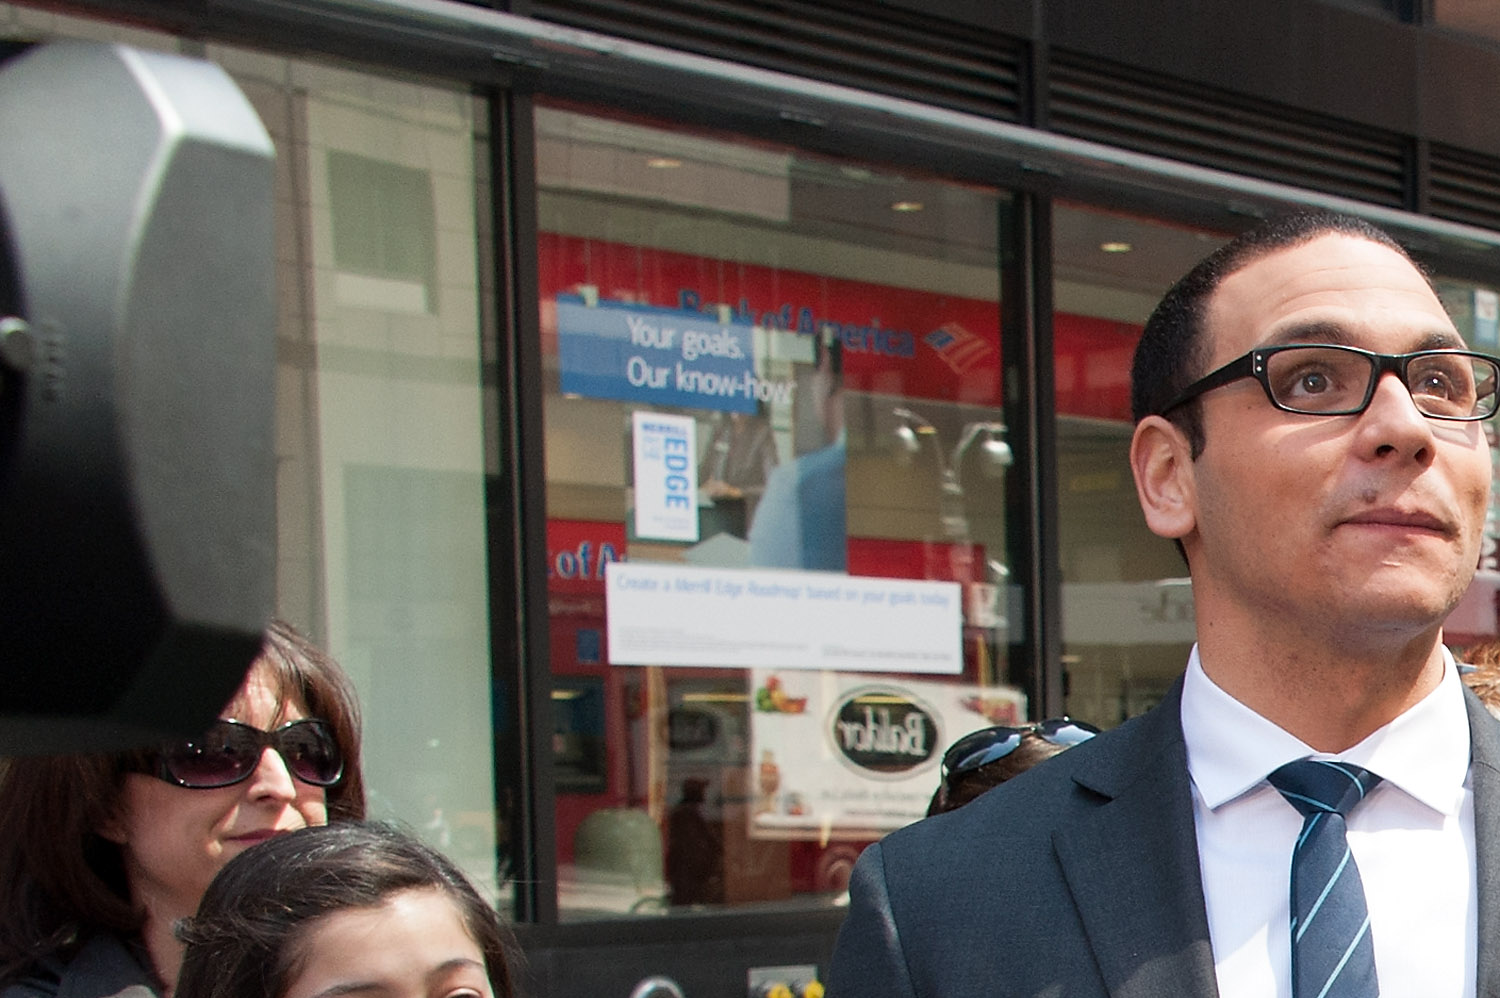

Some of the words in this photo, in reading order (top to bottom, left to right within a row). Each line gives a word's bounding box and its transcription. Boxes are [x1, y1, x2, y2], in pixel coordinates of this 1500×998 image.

[626, 316, 674, 349] Your
[682, 328, 745, 361] goals.
[627, 355, 671, 389] Our
[664, 437, 690, 510] EDGE
[554, 541, 591, 579] of
